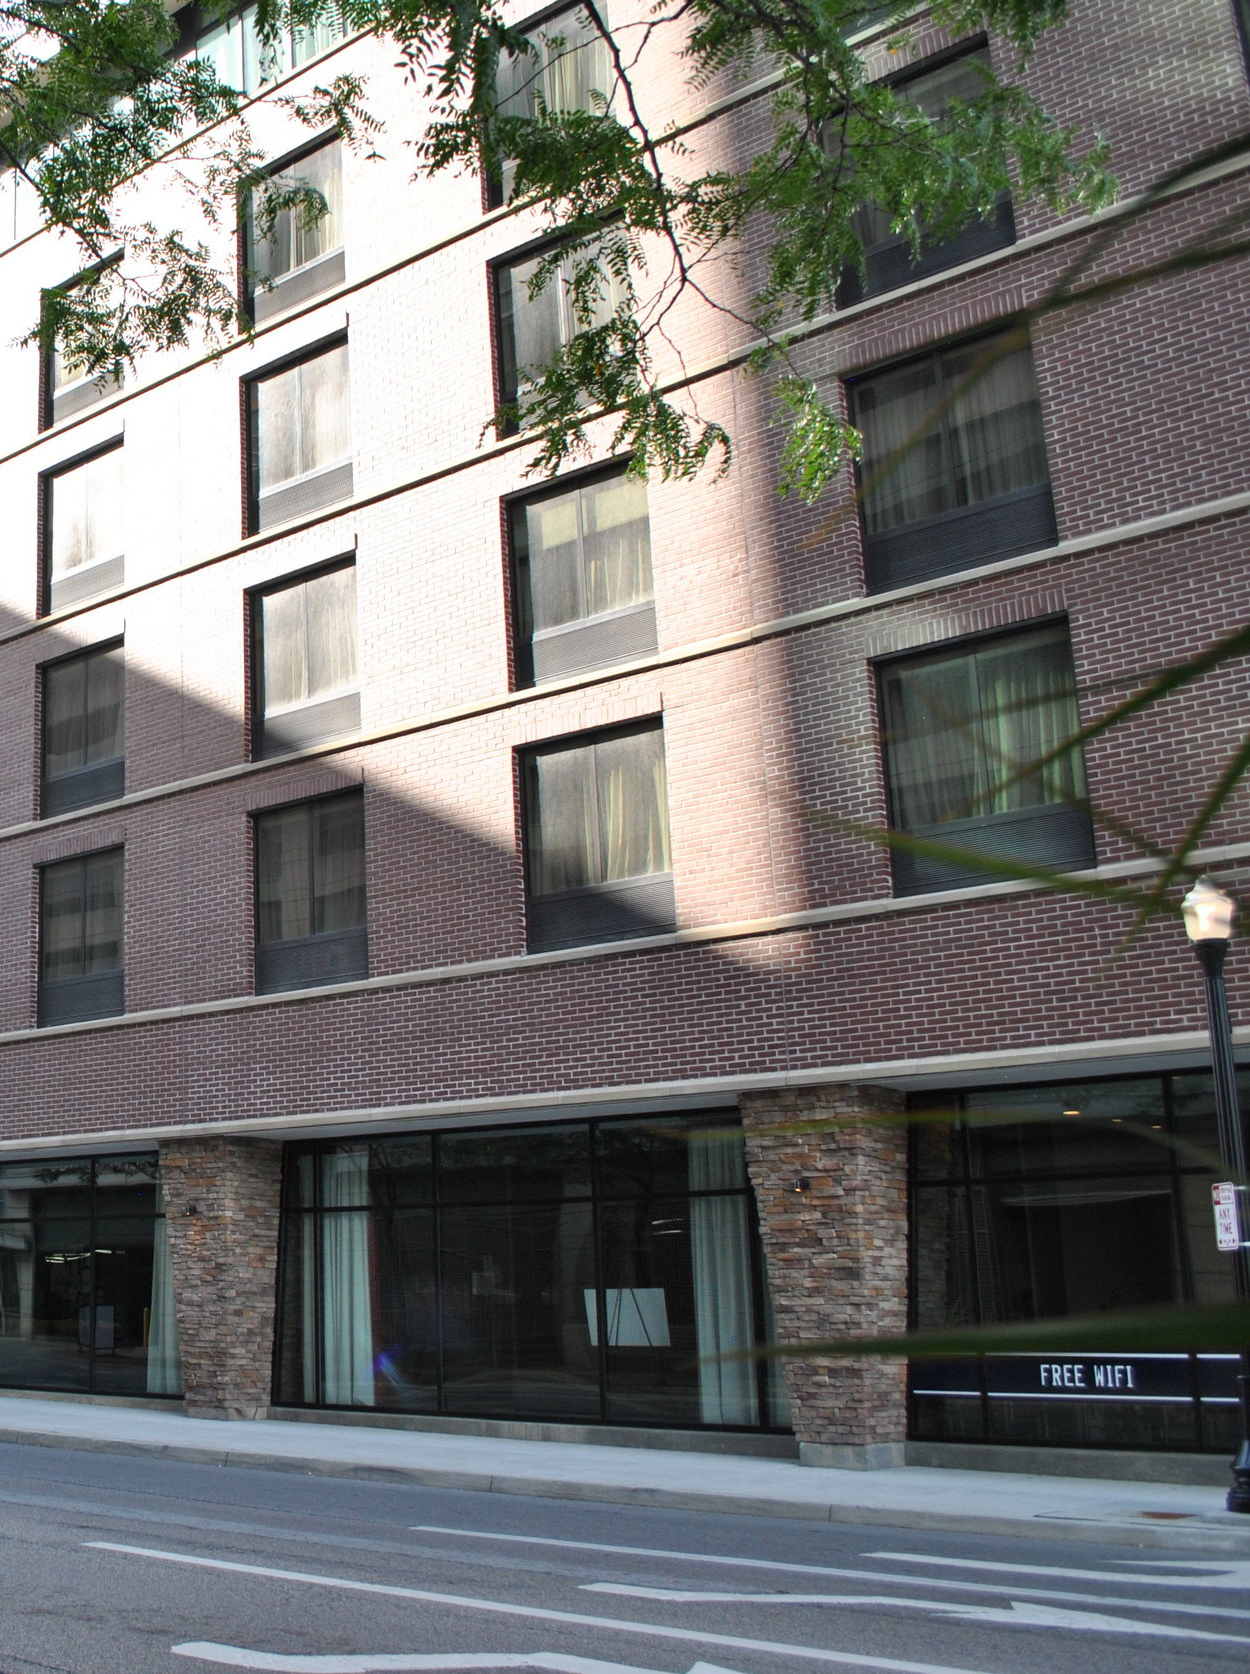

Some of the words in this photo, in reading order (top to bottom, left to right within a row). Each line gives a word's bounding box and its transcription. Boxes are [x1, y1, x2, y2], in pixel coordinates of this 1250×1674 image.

[1219, 1208, 1230, 1219] ANY
[1219, 1222, 1233, 1234] TIME
[1040, 1364, 1085, 1387] FREE
[1093, 1364, 1134, 1388] WIFI
